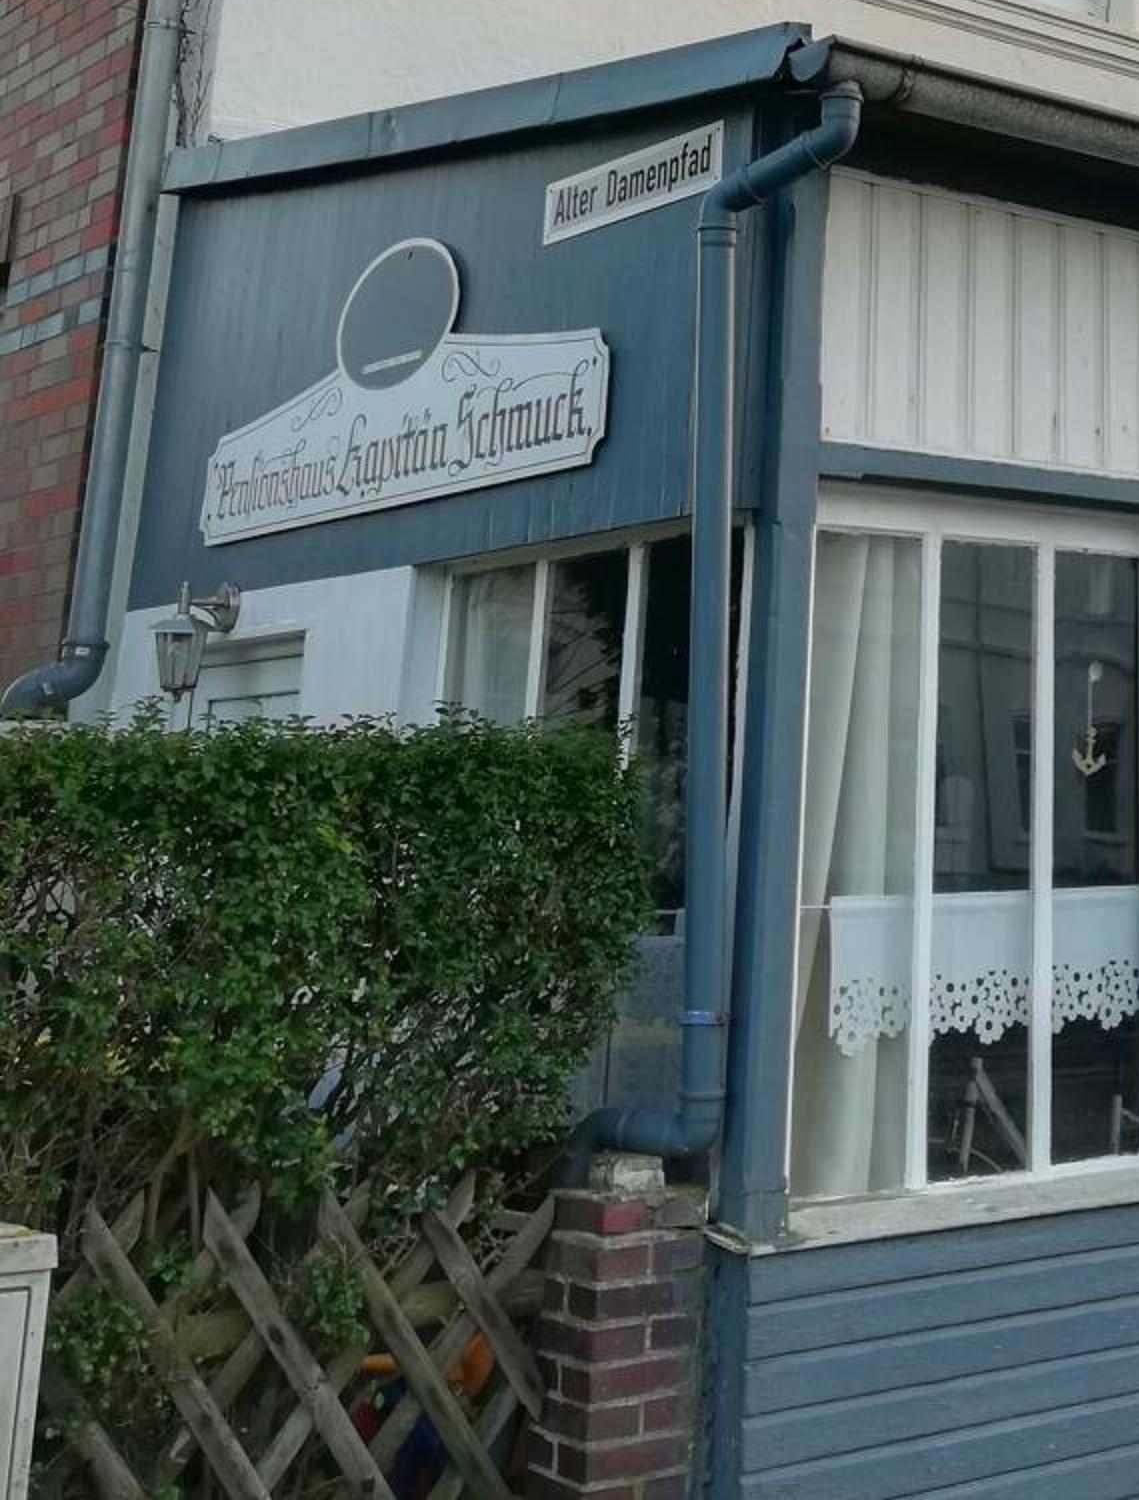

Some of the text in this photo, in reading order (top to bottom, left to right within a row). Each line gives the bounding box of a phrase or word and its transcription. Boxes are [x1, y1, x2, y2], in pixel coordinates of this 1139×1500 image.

[553, 134, 713, 226] Alter Damenpfad
[336, 408, 449, 494] Kapitän
[448, 360, 588, 476] Schmuck
